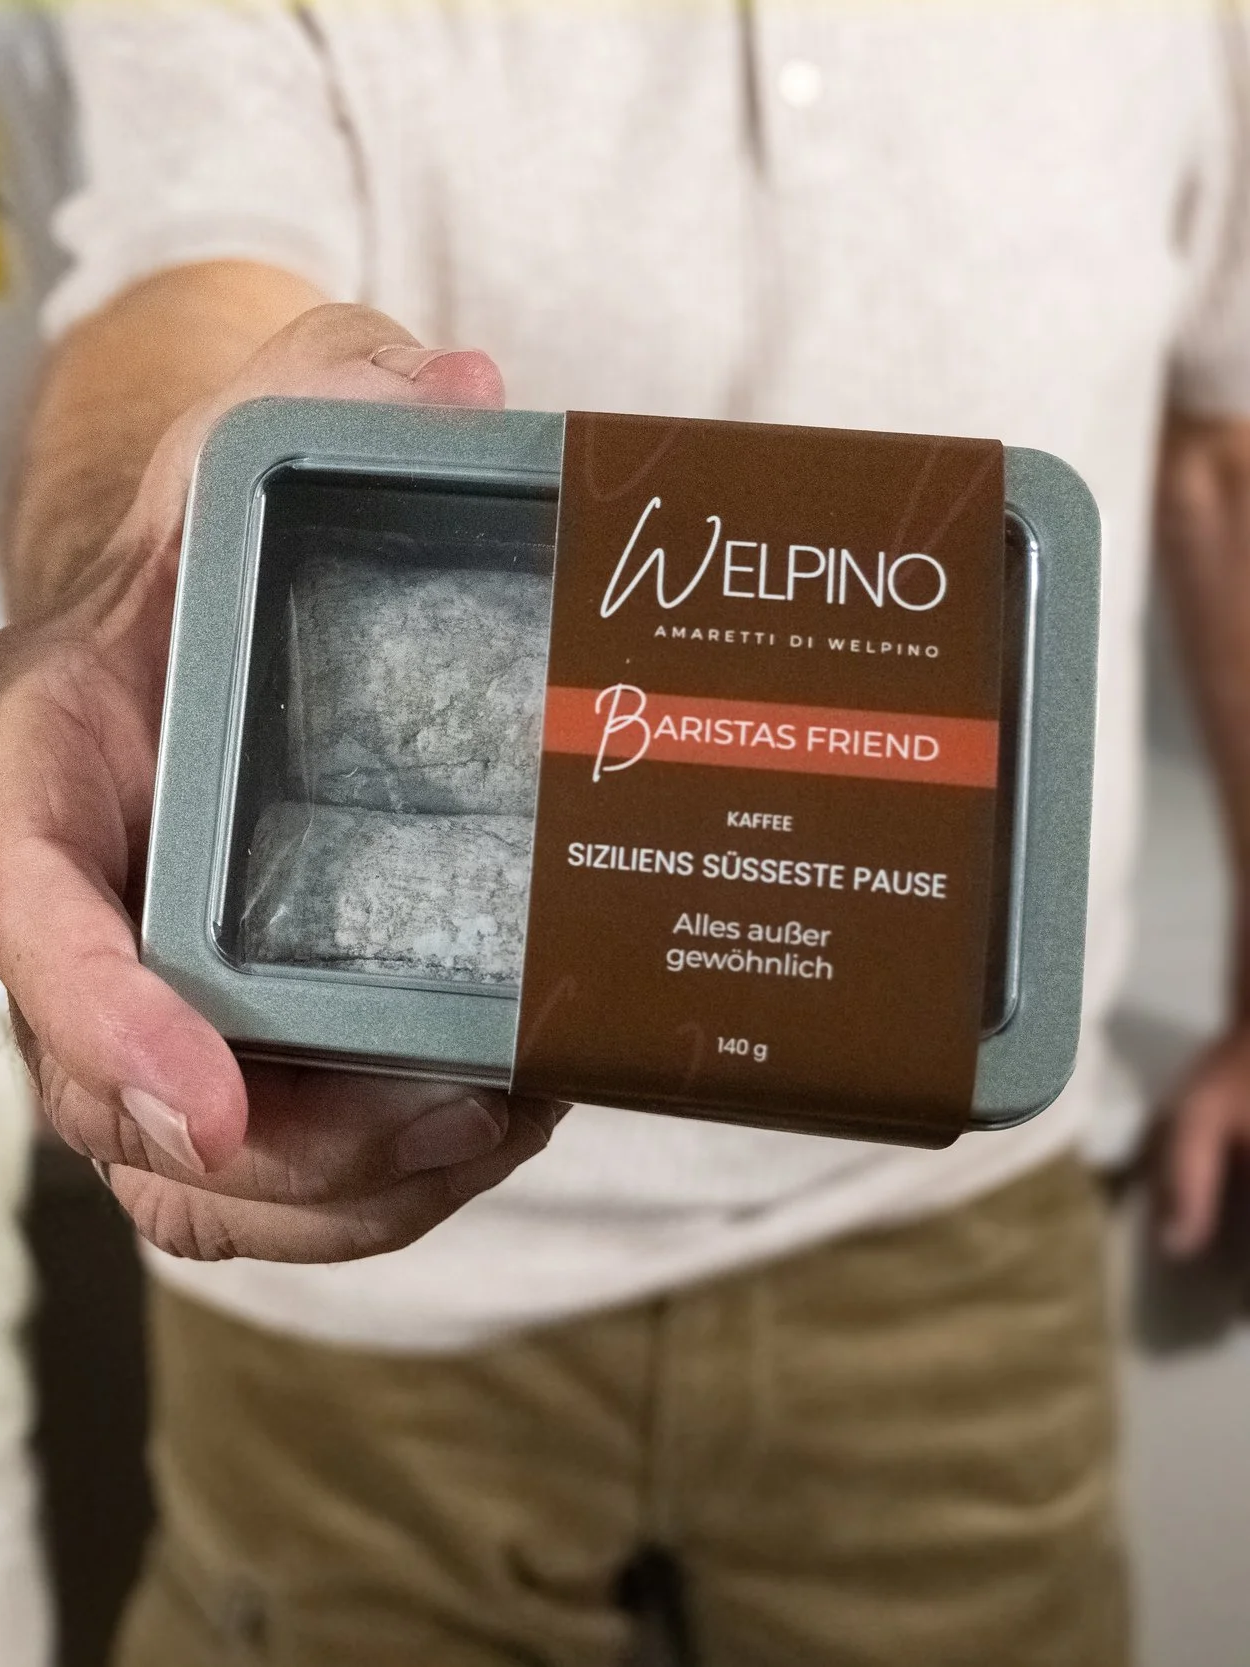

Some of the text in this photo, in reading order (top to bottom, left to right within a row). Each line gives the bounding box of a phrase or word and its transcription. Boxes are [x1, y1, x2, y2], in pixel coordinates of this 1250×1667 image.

[600, 497, 947, 618] WELPINO
[654, 625, 940, 658] AMARETTI DI WELPINO
[592, 683, 940, 782] BARISTAS FRIEND
[727, 811, 793, 832] KAFFEE
[567, 842, 948, 899] SIZILIENS SÜSSESTE PAUSE
[672, 913, 831, 947] Alles außer
[666, 945, 833, 980] gewöhnlich
[717, 1037, 768, 1062] 140 g
